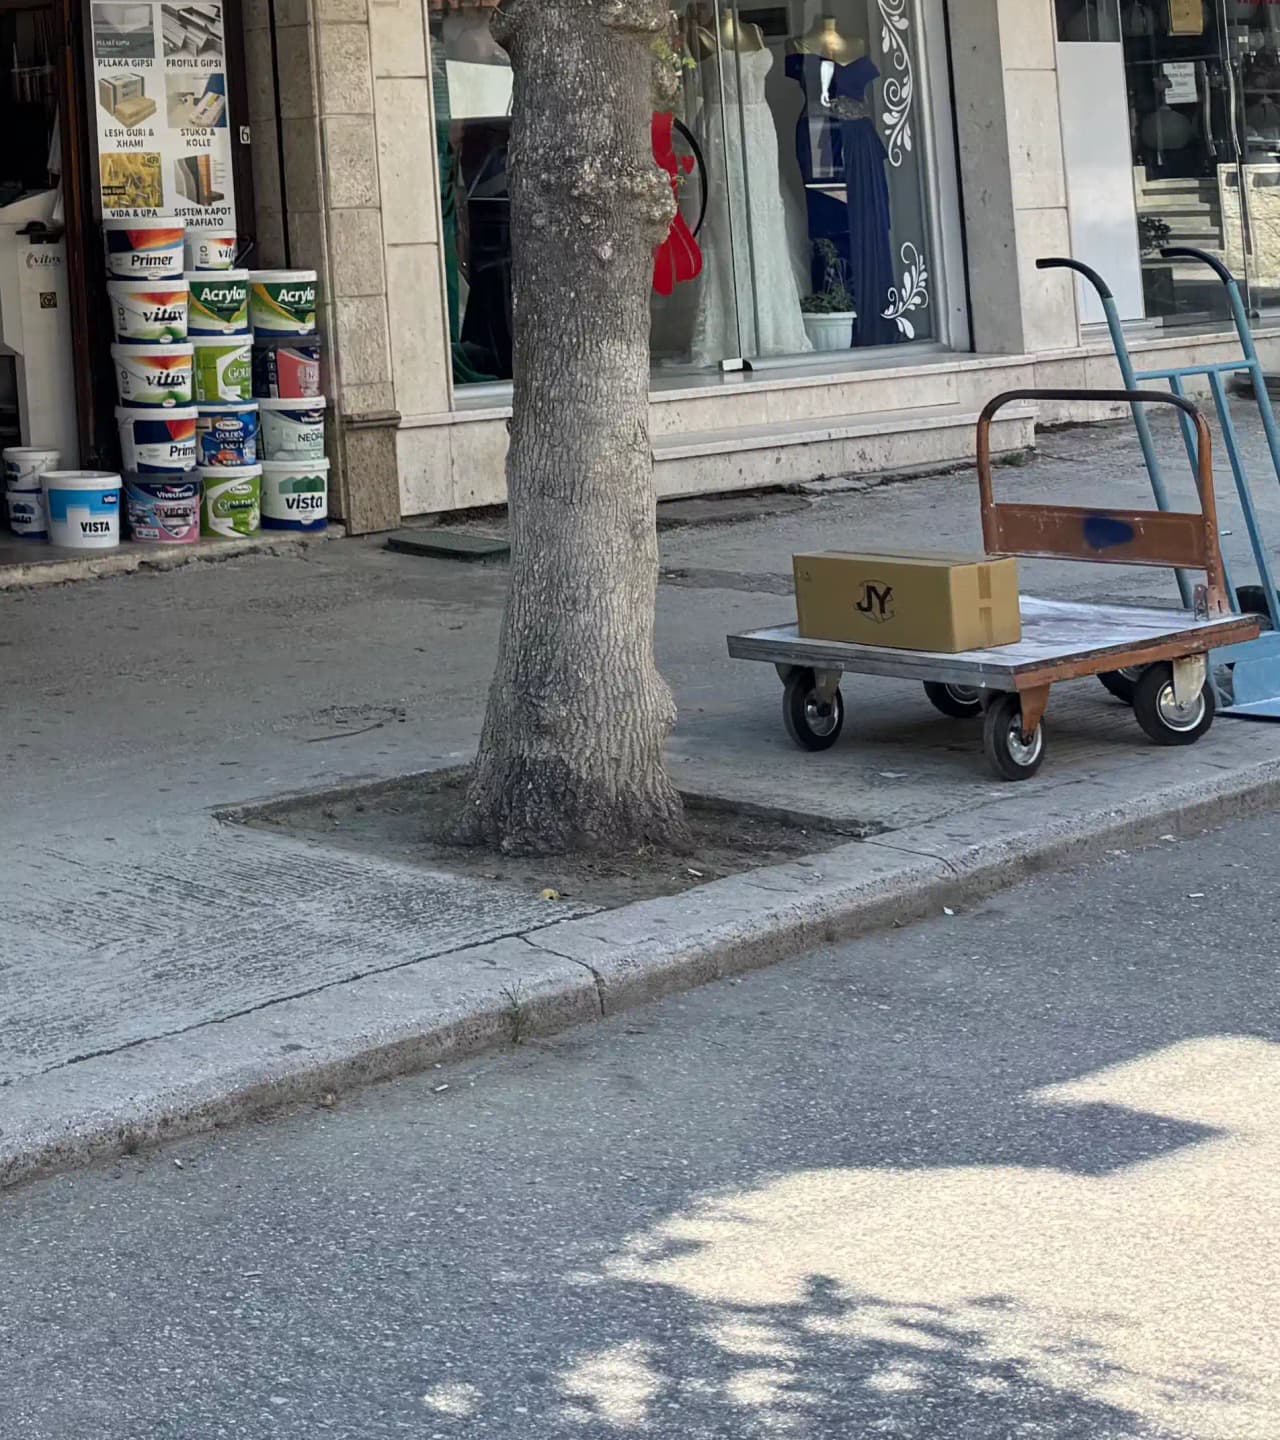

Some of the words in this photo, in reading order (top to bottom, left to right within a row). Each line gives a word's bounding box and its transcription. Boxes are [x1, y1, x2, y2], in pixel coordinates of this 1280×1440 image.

[98, 59, 129, 68] PLLAKA
[131, 59, 153, 68] GIPSI
[166, 58, 198, 68] PROFILE
[200, 59, 222, 68] GIPSI
[104, 128, 124, 137] LESH
[126, 128, 145, 137] GURI
[180, 128, 207, 137] STUKO
[116, 139, 144, 148] XHAMI
[186, 138, 211, 147] KOLLE
[111, 208, 130, 217] VIDA
[174, 208, 202, 217] SISTEM
[204, 206, 231, 216] KAPOT
[131, 254, 173, 266] Primer
[277, 287, 315, 303] Acryla
[169, 445, 196, 458] Prim
[285, 494, 323, 510] vista
[80, 521, 110, 534] VISTA
[856, 584, 894, 615] JY
